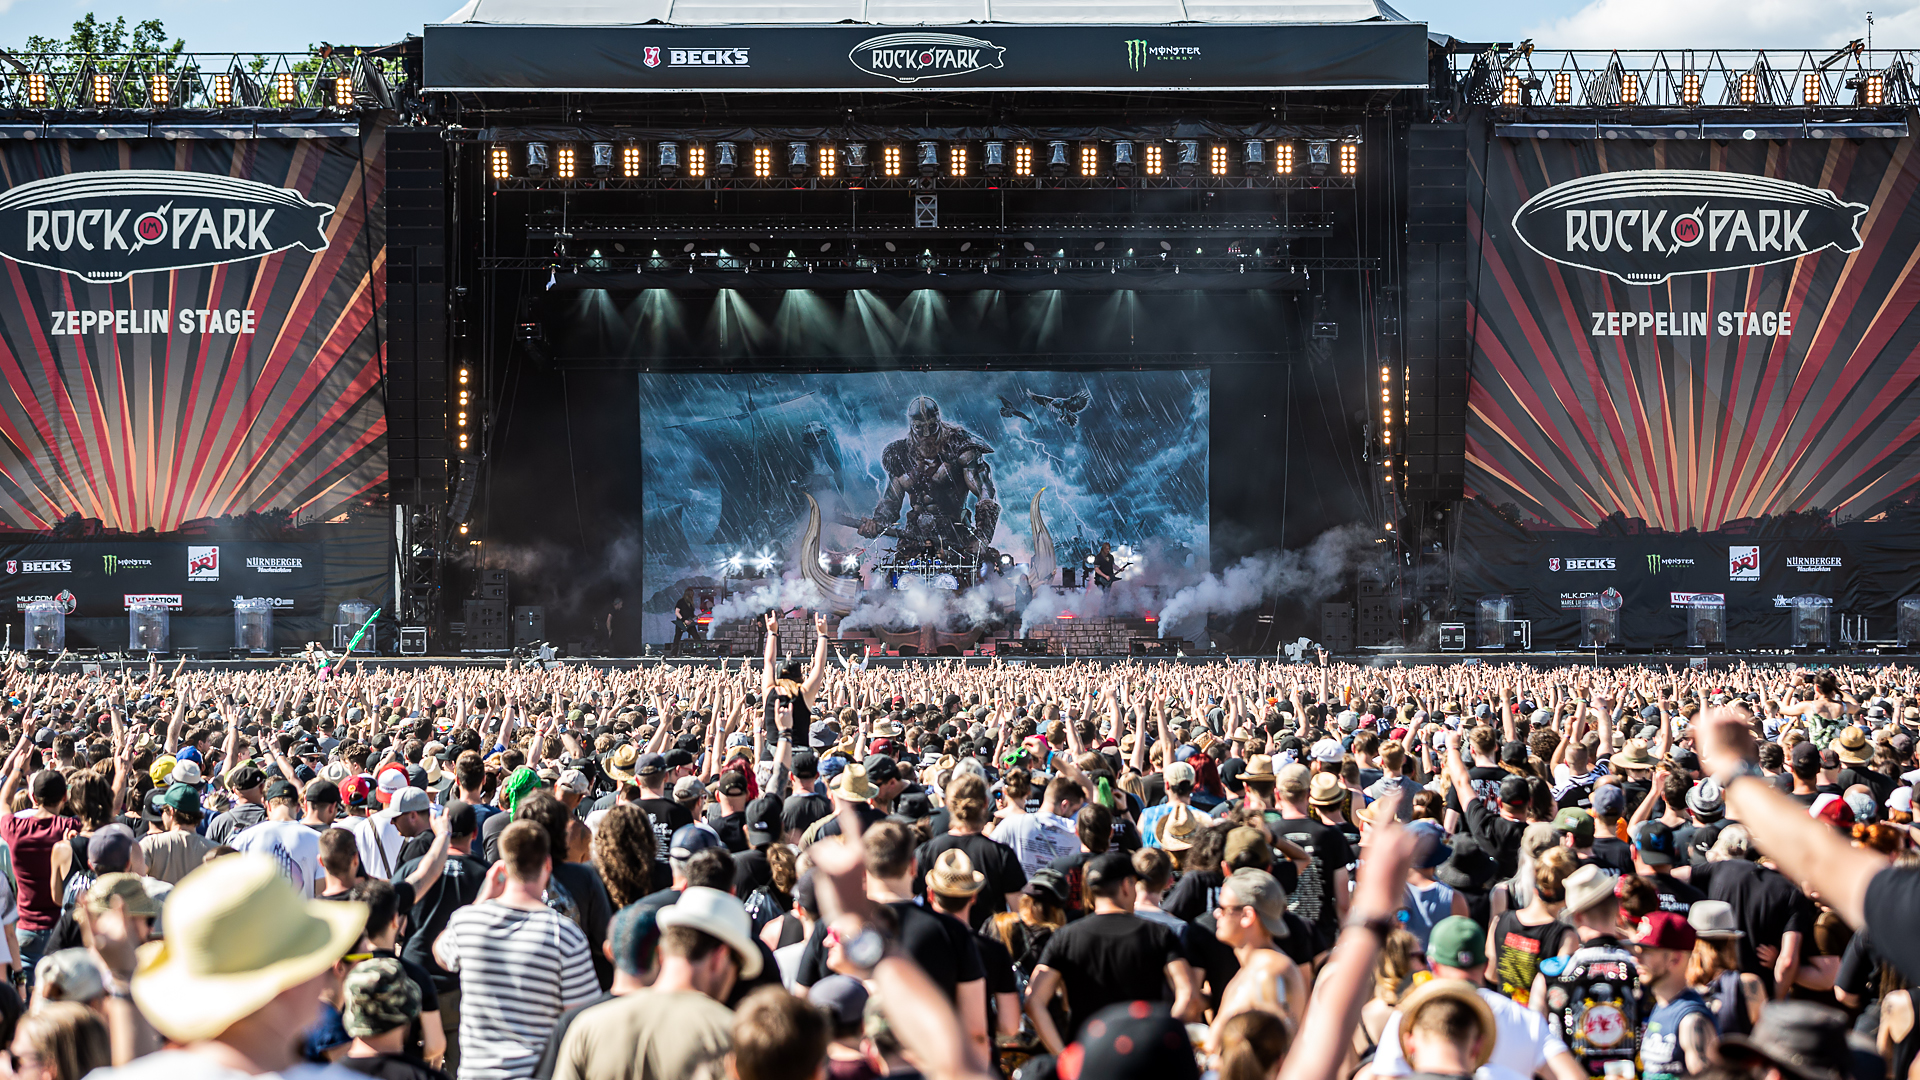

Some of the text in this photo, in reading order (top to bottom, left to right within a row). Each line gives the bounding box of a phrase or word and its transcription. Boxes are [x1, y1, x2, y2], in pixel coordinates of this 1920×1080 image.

[670, 47, 749, 65] BECK'S
[1149, 45, 1201, 56] MONSTER
[872, 49, 918, 69] ROCK
[935, 49, 981, 69] PARK
[27, 208, 275, 251] ROCK IM PARK
[1566, 209, 1810, 252] ROCK IM PARK
[51, 309, 255, 335] ZEPPELIN STAGE
[1591, 311, 1791, 336] ZEPPELIN STAGE
[22, 560, 72, 572] BECK'S
[117, 558, 152, 566] MONSTER
[1566, 558, 1616, 570] BECK'S
[1661, 557, 1695, 565] MONSTER
[1674, 594, 1691, 602] LIVE
